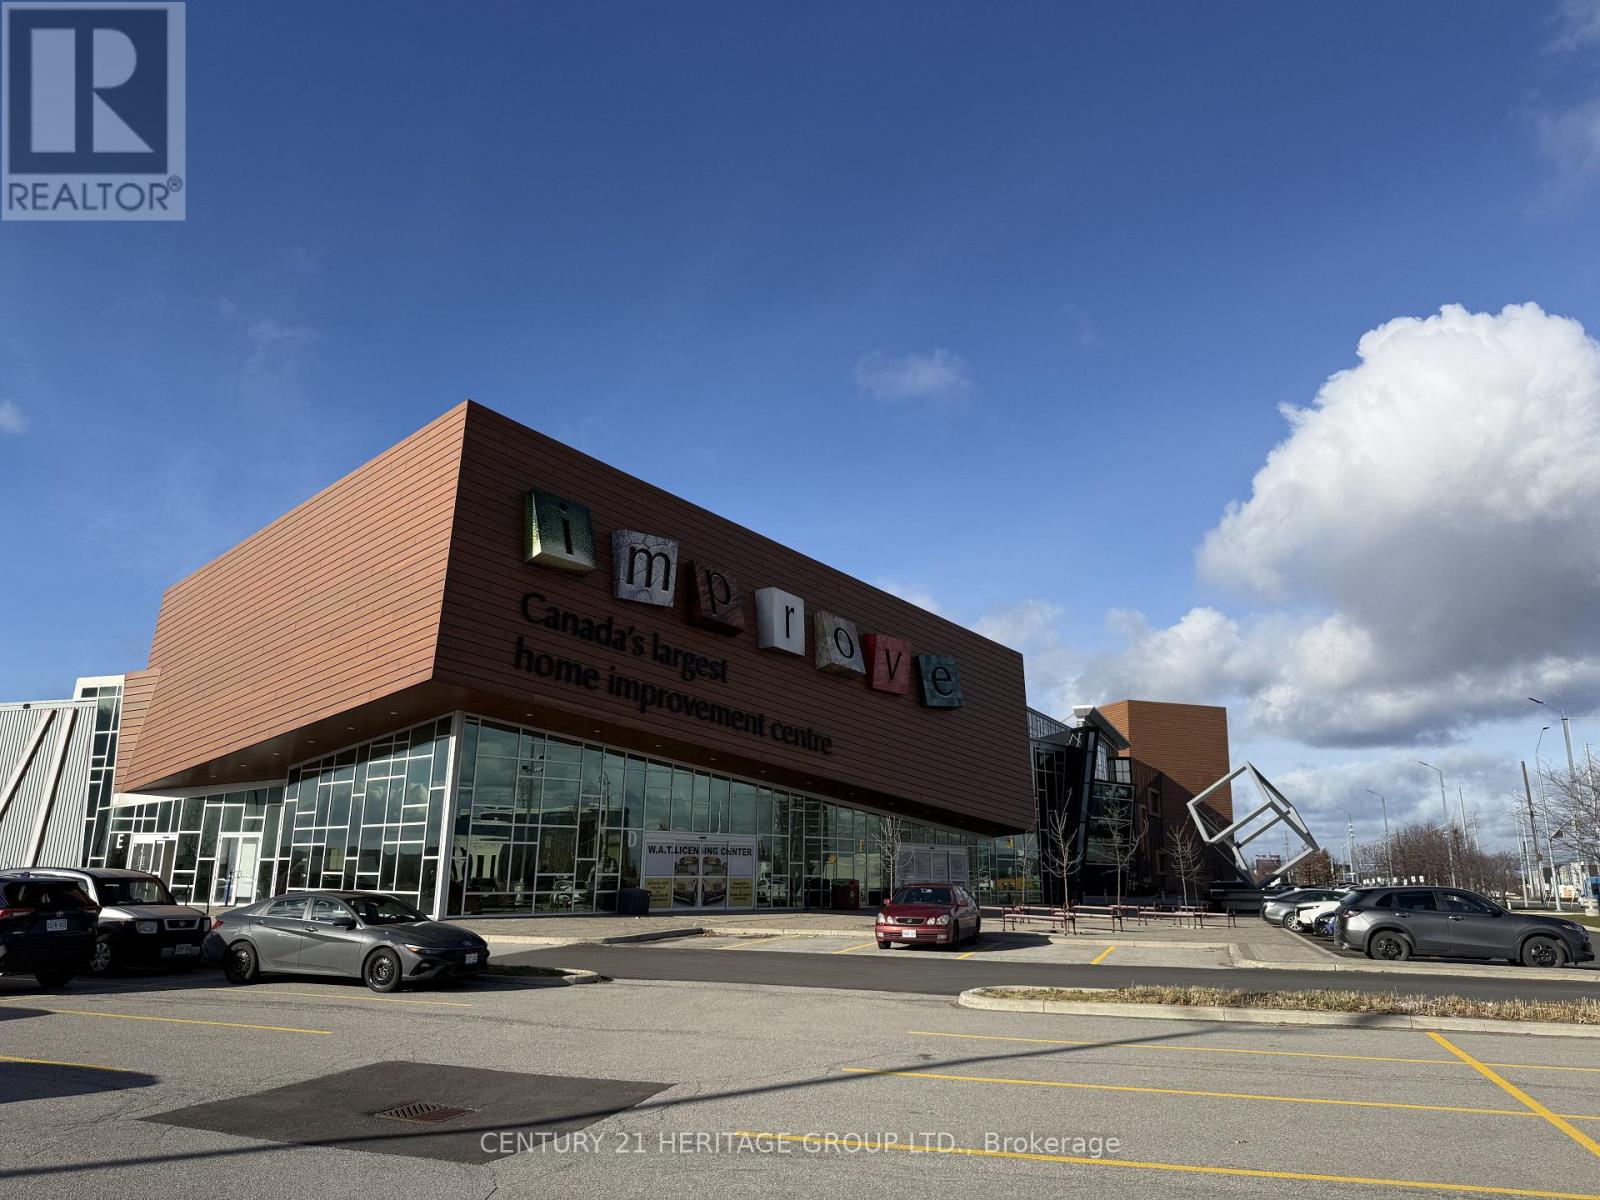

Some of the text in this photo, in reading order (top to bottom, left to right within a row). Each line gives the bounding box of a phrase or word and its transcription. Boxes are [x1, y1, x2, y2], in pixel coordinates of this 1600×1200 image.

[558, 501, 953, 698] improve
[521, 591, 729, 684] Canada's largest
[514, 635, 833, 755] home improvement centre
[116, 833, 125, 849] E
[627, 830, 637, 848] D
[720, 846, 752, 858] CENTER
